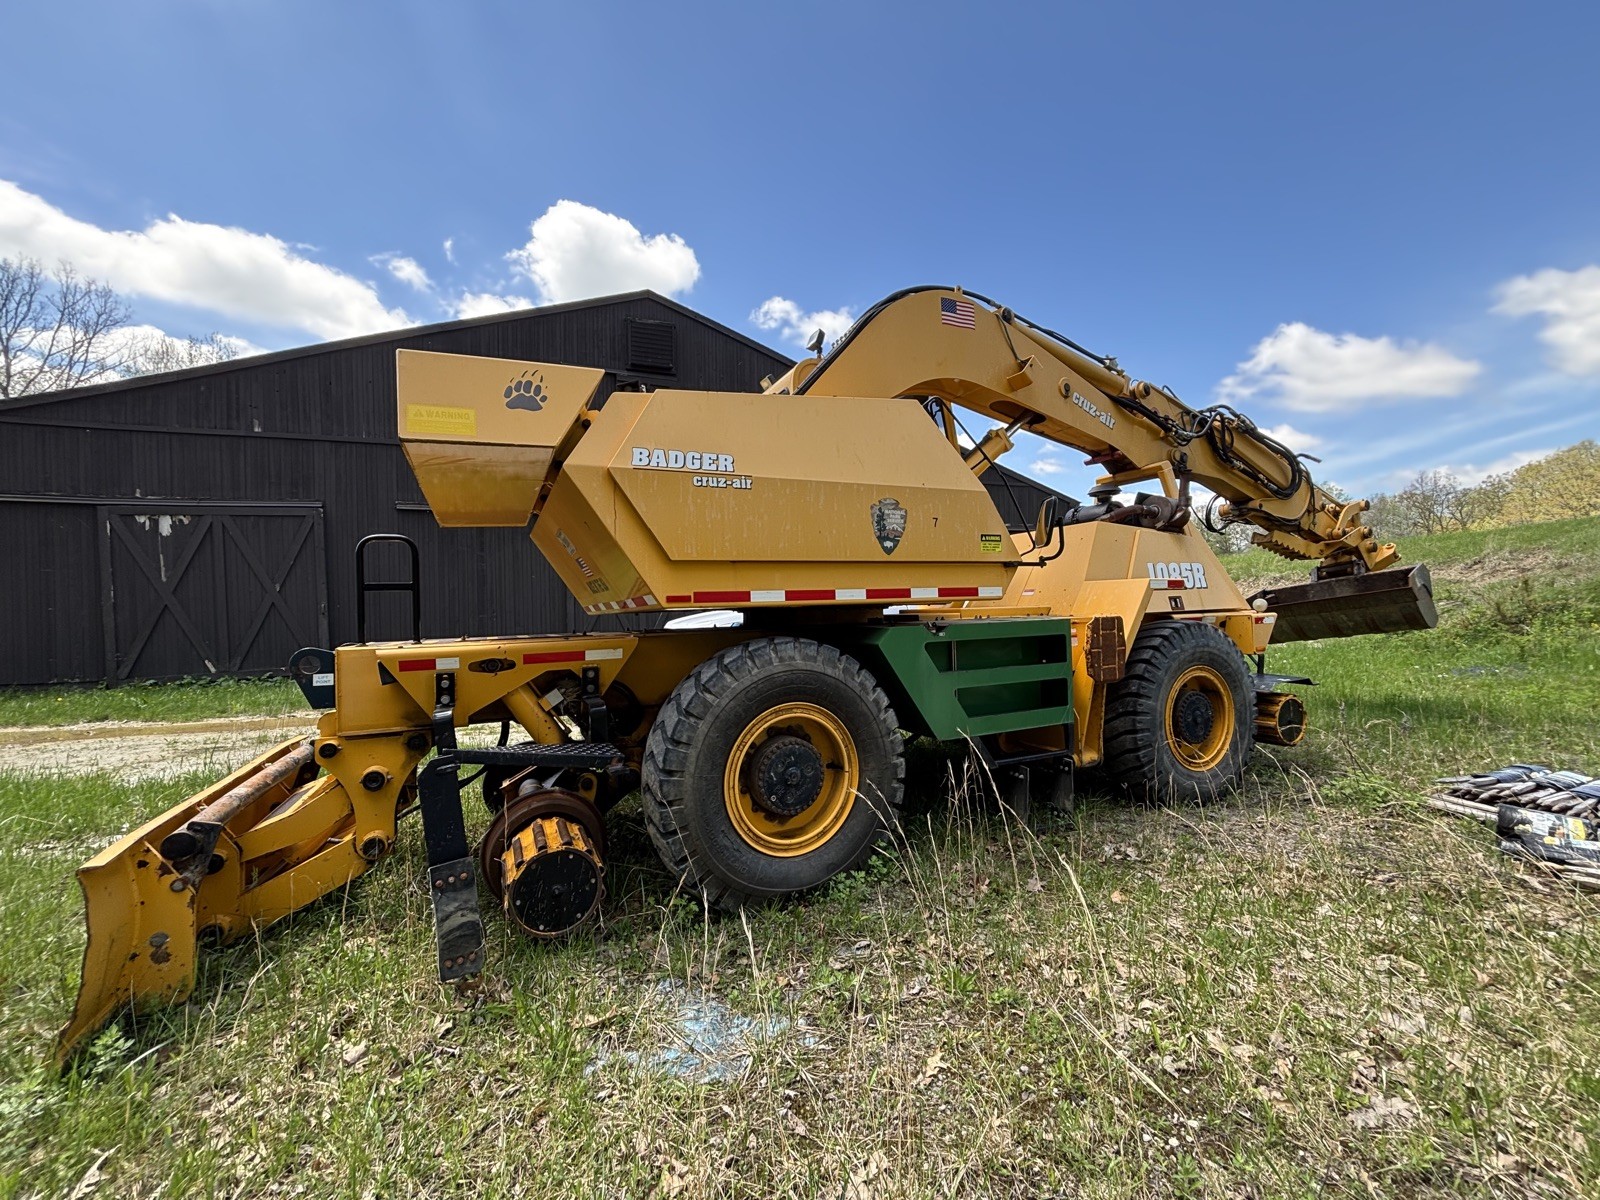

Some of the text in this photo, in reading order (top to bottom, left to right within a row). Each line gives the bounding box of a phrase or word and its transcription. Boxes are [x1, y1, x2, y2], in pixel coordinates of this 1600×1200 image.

[425, 409, 470, 420] WARNING
[1072, 391, 1116, 430] cruz-air
[631, 447, 735, 472] BADGER
[693, 476, 753, 490] cruz-air
[932, 517, 939, 528] 7
